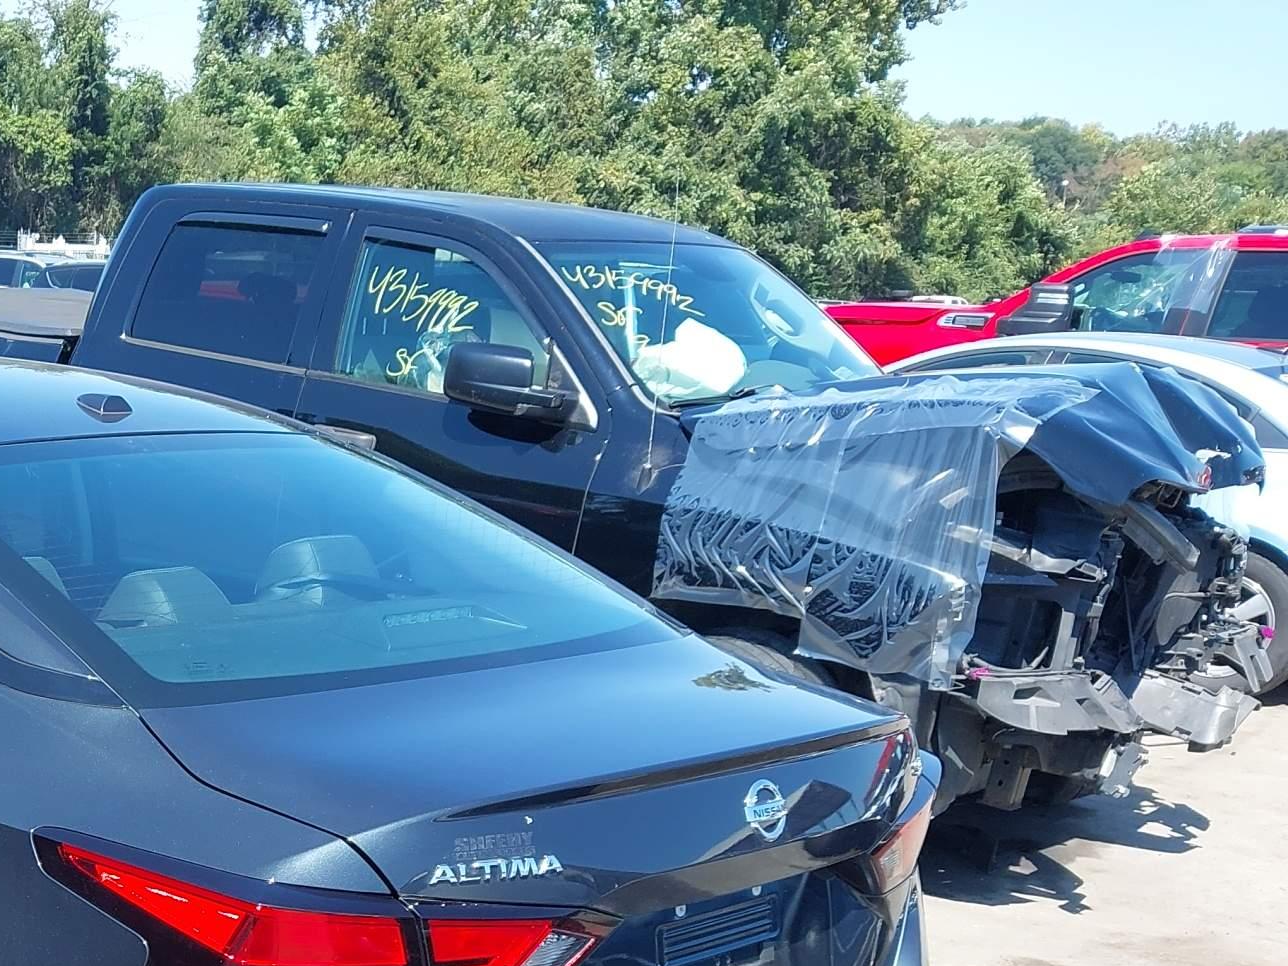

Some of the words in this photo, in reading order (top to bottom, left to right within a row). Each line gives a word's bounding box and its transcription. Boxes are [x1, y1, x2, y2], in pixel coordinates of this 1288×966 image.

[367, 264, 480, 332] 43159992
[561, 264, 707, 317] 43159992
[429, 854, 565, 885] ALTIMA
